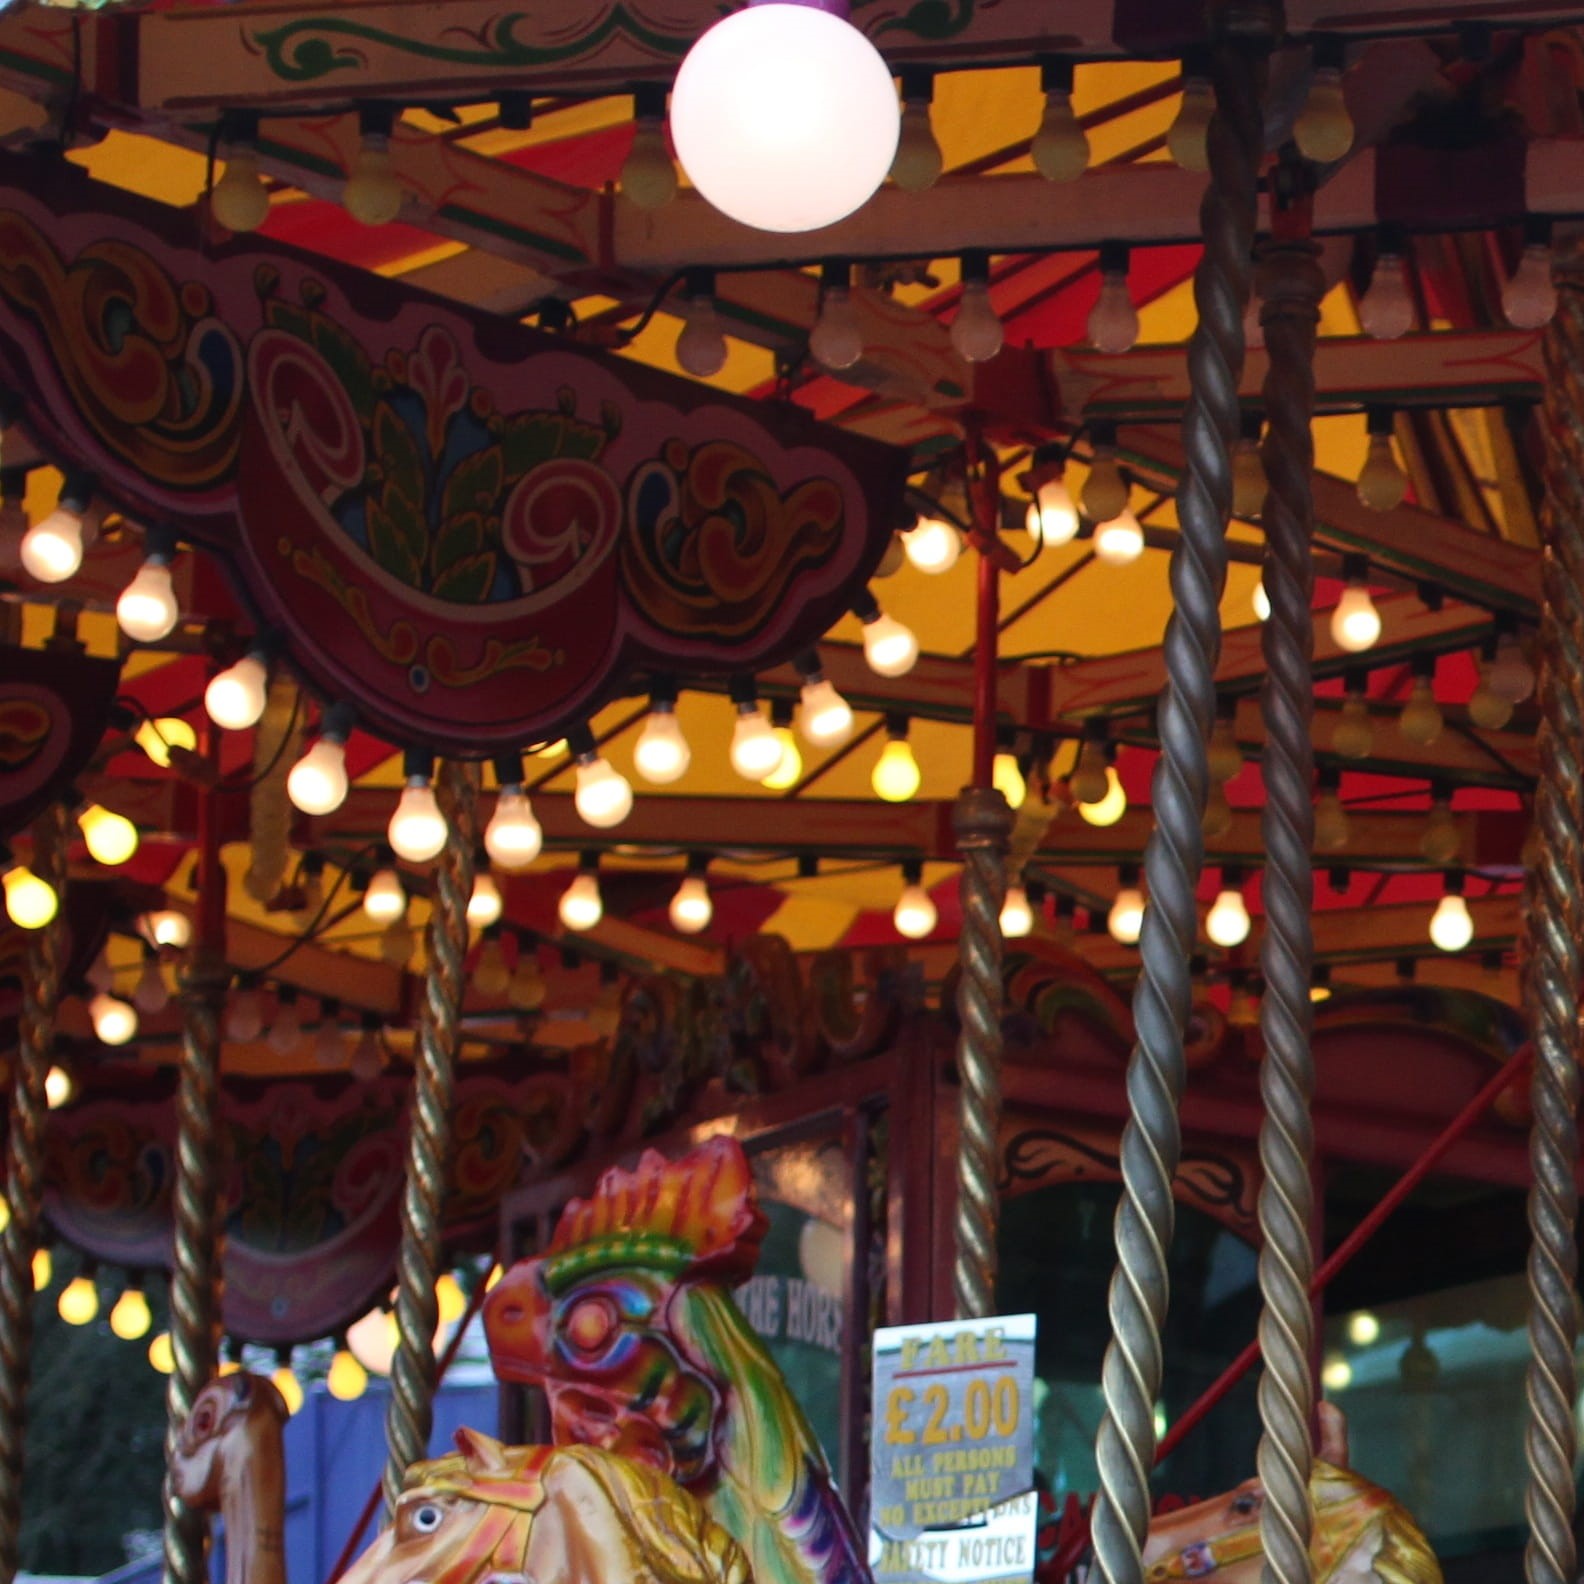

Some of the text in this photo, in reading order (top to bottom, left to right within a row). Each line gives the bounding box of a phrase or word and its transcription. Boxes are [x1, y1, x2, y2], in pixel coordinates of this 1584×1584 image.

[900, 1327, 1007, 1369] FARE
[884, 1375, 1020, 1445] £2.00
[890, 1446, 1017, 1478] ALL PERSONS
[905, 1471, 1000, 1500] MUST PAY
[880, 1506, 905, 1527] NO
[914, 1494, 1032, 1526] EXCEPTIONS
[880, 1535, 1026, 1574] SAFETY NOTICE
